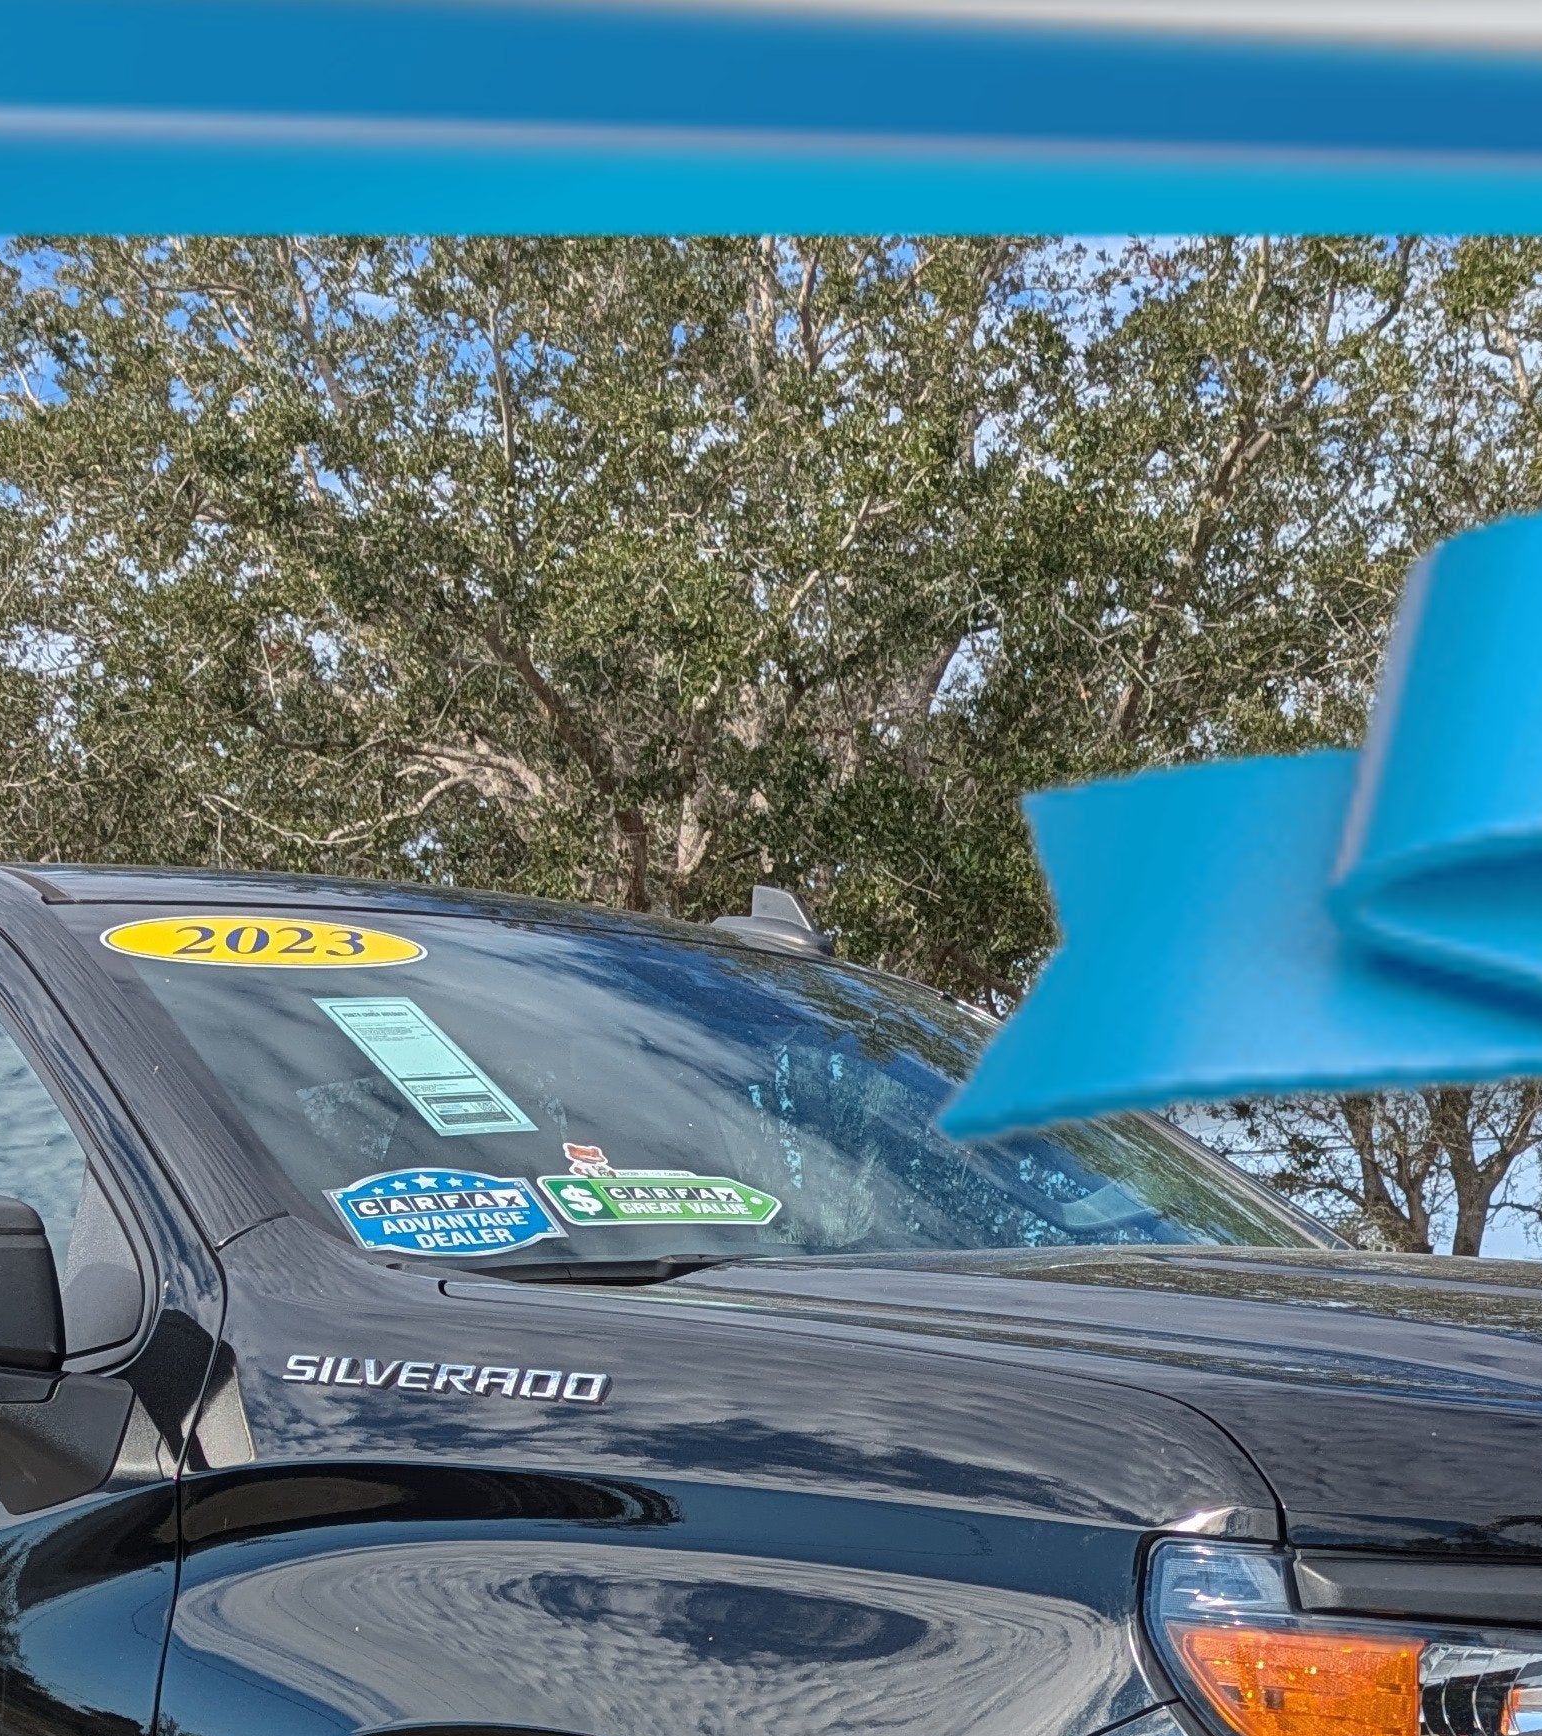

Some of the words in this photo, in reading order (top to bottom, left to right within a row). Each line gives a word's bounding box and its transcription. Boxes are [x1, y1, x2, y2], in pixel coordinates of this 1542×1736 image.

[172, 925, 366, 957] 2023
[354, 1190, 528, 1217] CARFAX
[606, 1186, 743, 1203] CARFAX
[617, 1202, 684, 1215] GREAT
[686, 1202, 753, 1216] VALUE
[414, 1228, 517, 1249] DEALER
[281, 1353, 611, 1404] SILVERADO
